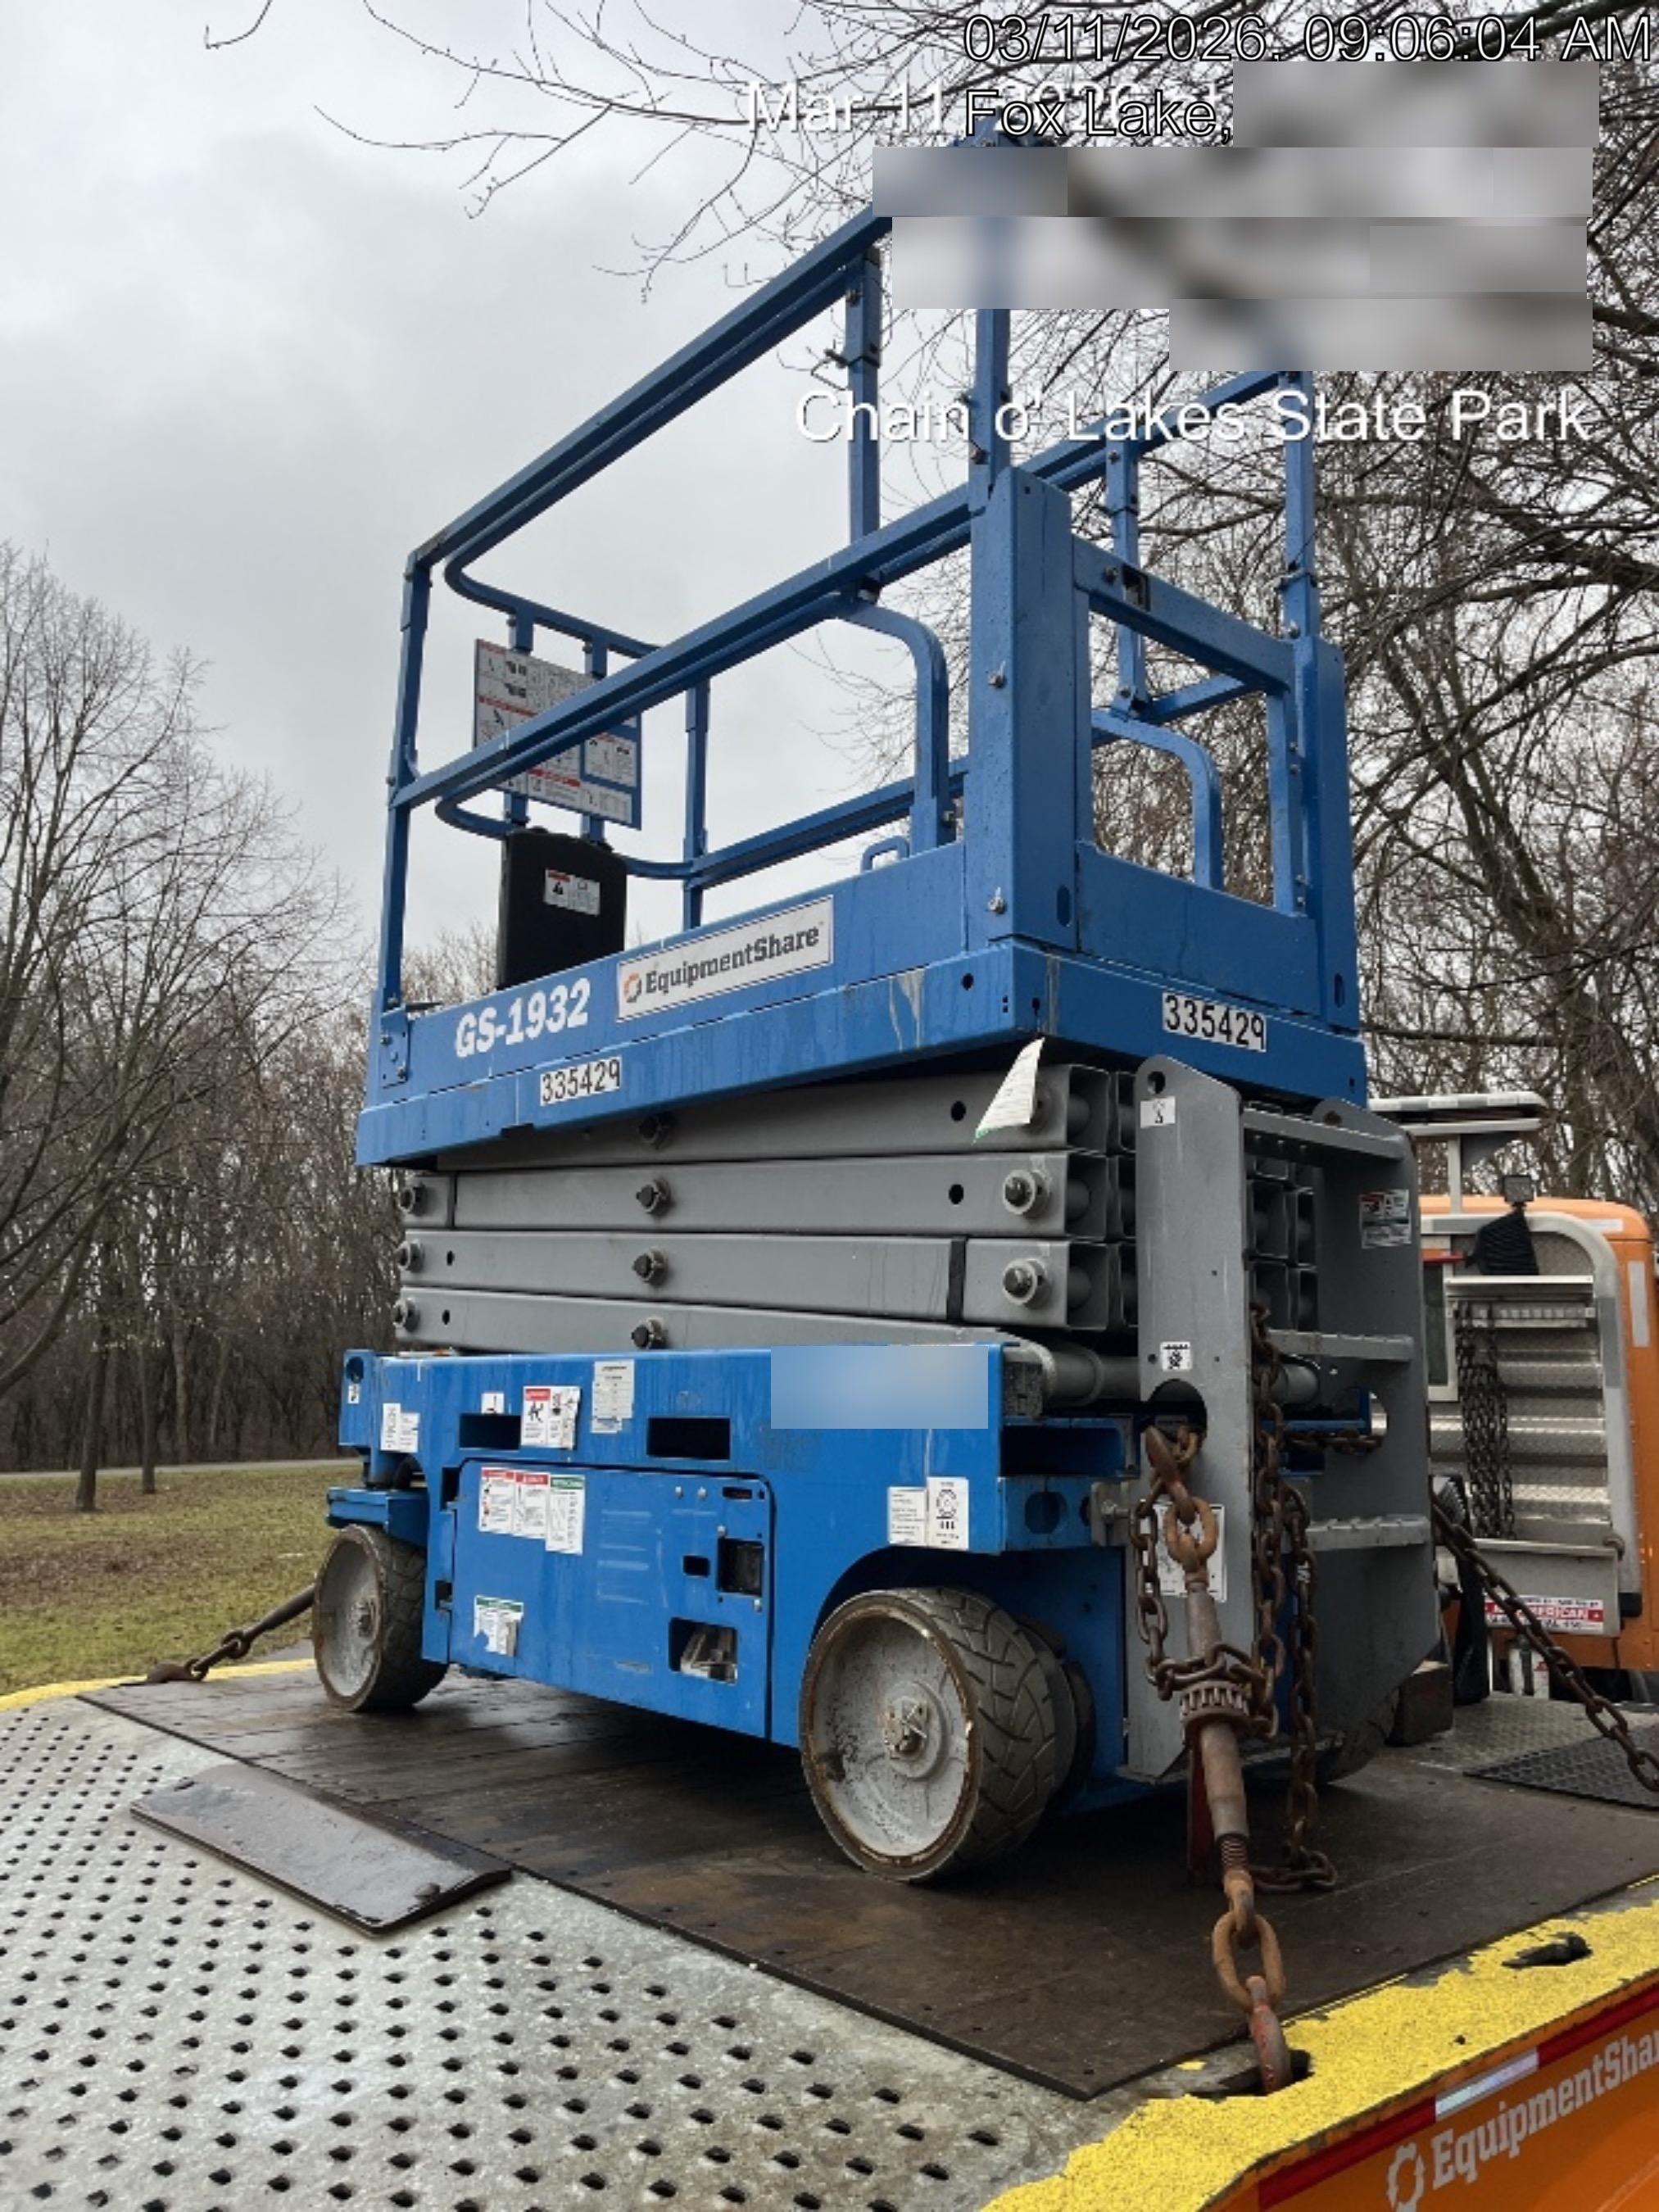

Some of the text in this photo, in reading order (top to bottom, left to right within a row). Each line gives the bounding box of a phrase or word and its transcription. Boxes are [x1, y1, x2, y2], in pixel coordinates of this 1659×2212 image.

[645, 924, 820, 995] EquipmentShare
[456, 977, 591, 1058] GS-1932
[1165, 994, 1265, 1050] 335429
[542, 1058, 621, 1103] 335429
